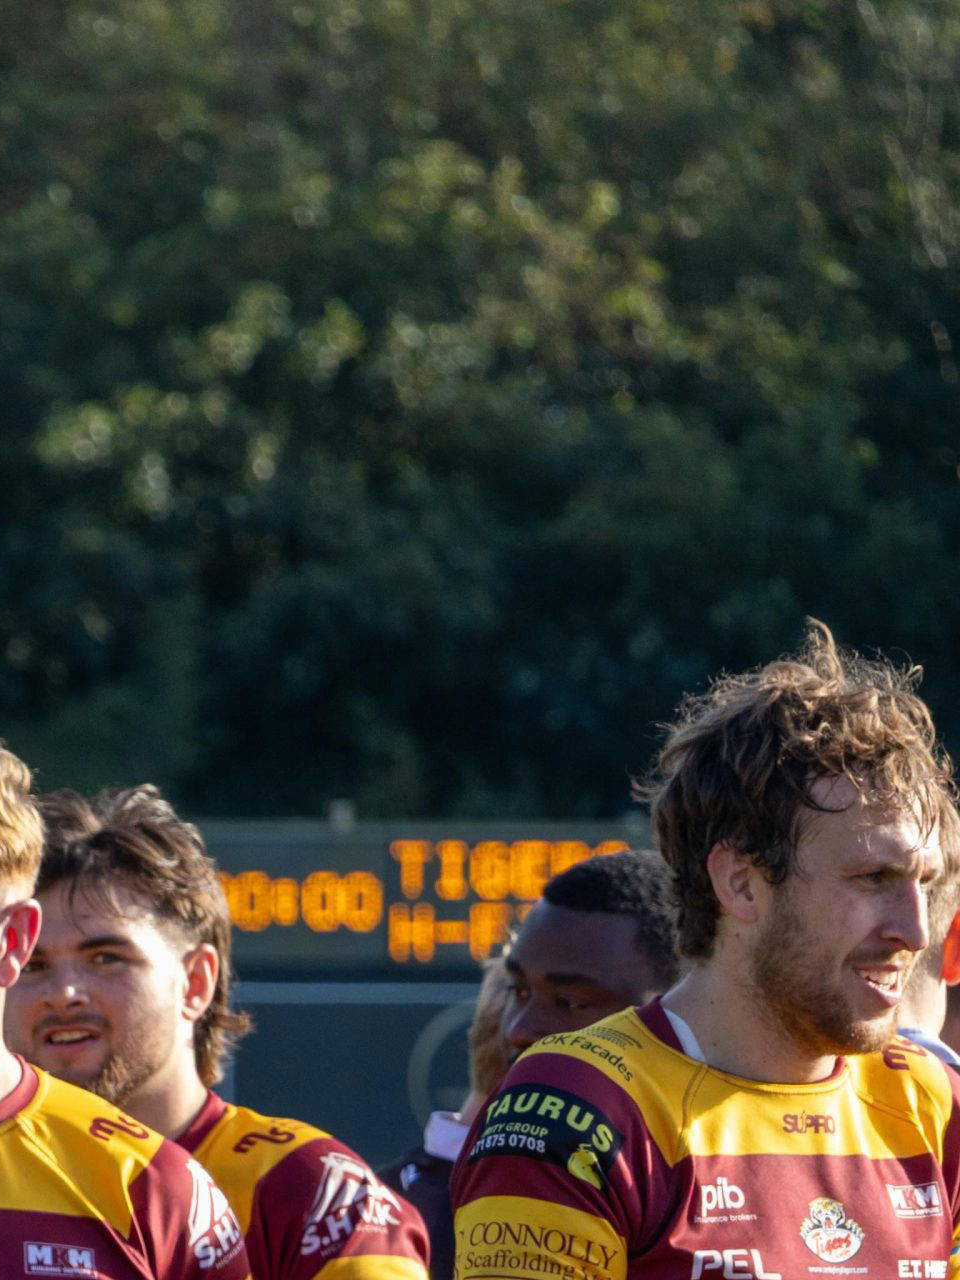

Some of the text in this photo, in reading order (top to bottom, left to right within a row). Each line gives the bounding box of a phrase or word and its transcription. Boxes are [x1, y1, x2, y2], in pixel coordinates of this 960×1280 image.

[571, 1034, 634, 1083] Facades
[486, 1092, 614, 1153] TAURUS
[505, 1121, 549, 1138] GROUP
[508, 1133, 547, 1154] 0708
[701, 1176, 746, 1217] pib
[26, 1243, 93, 1268] MKM
[470, 1221, 618, 1271] CONNOLLY
